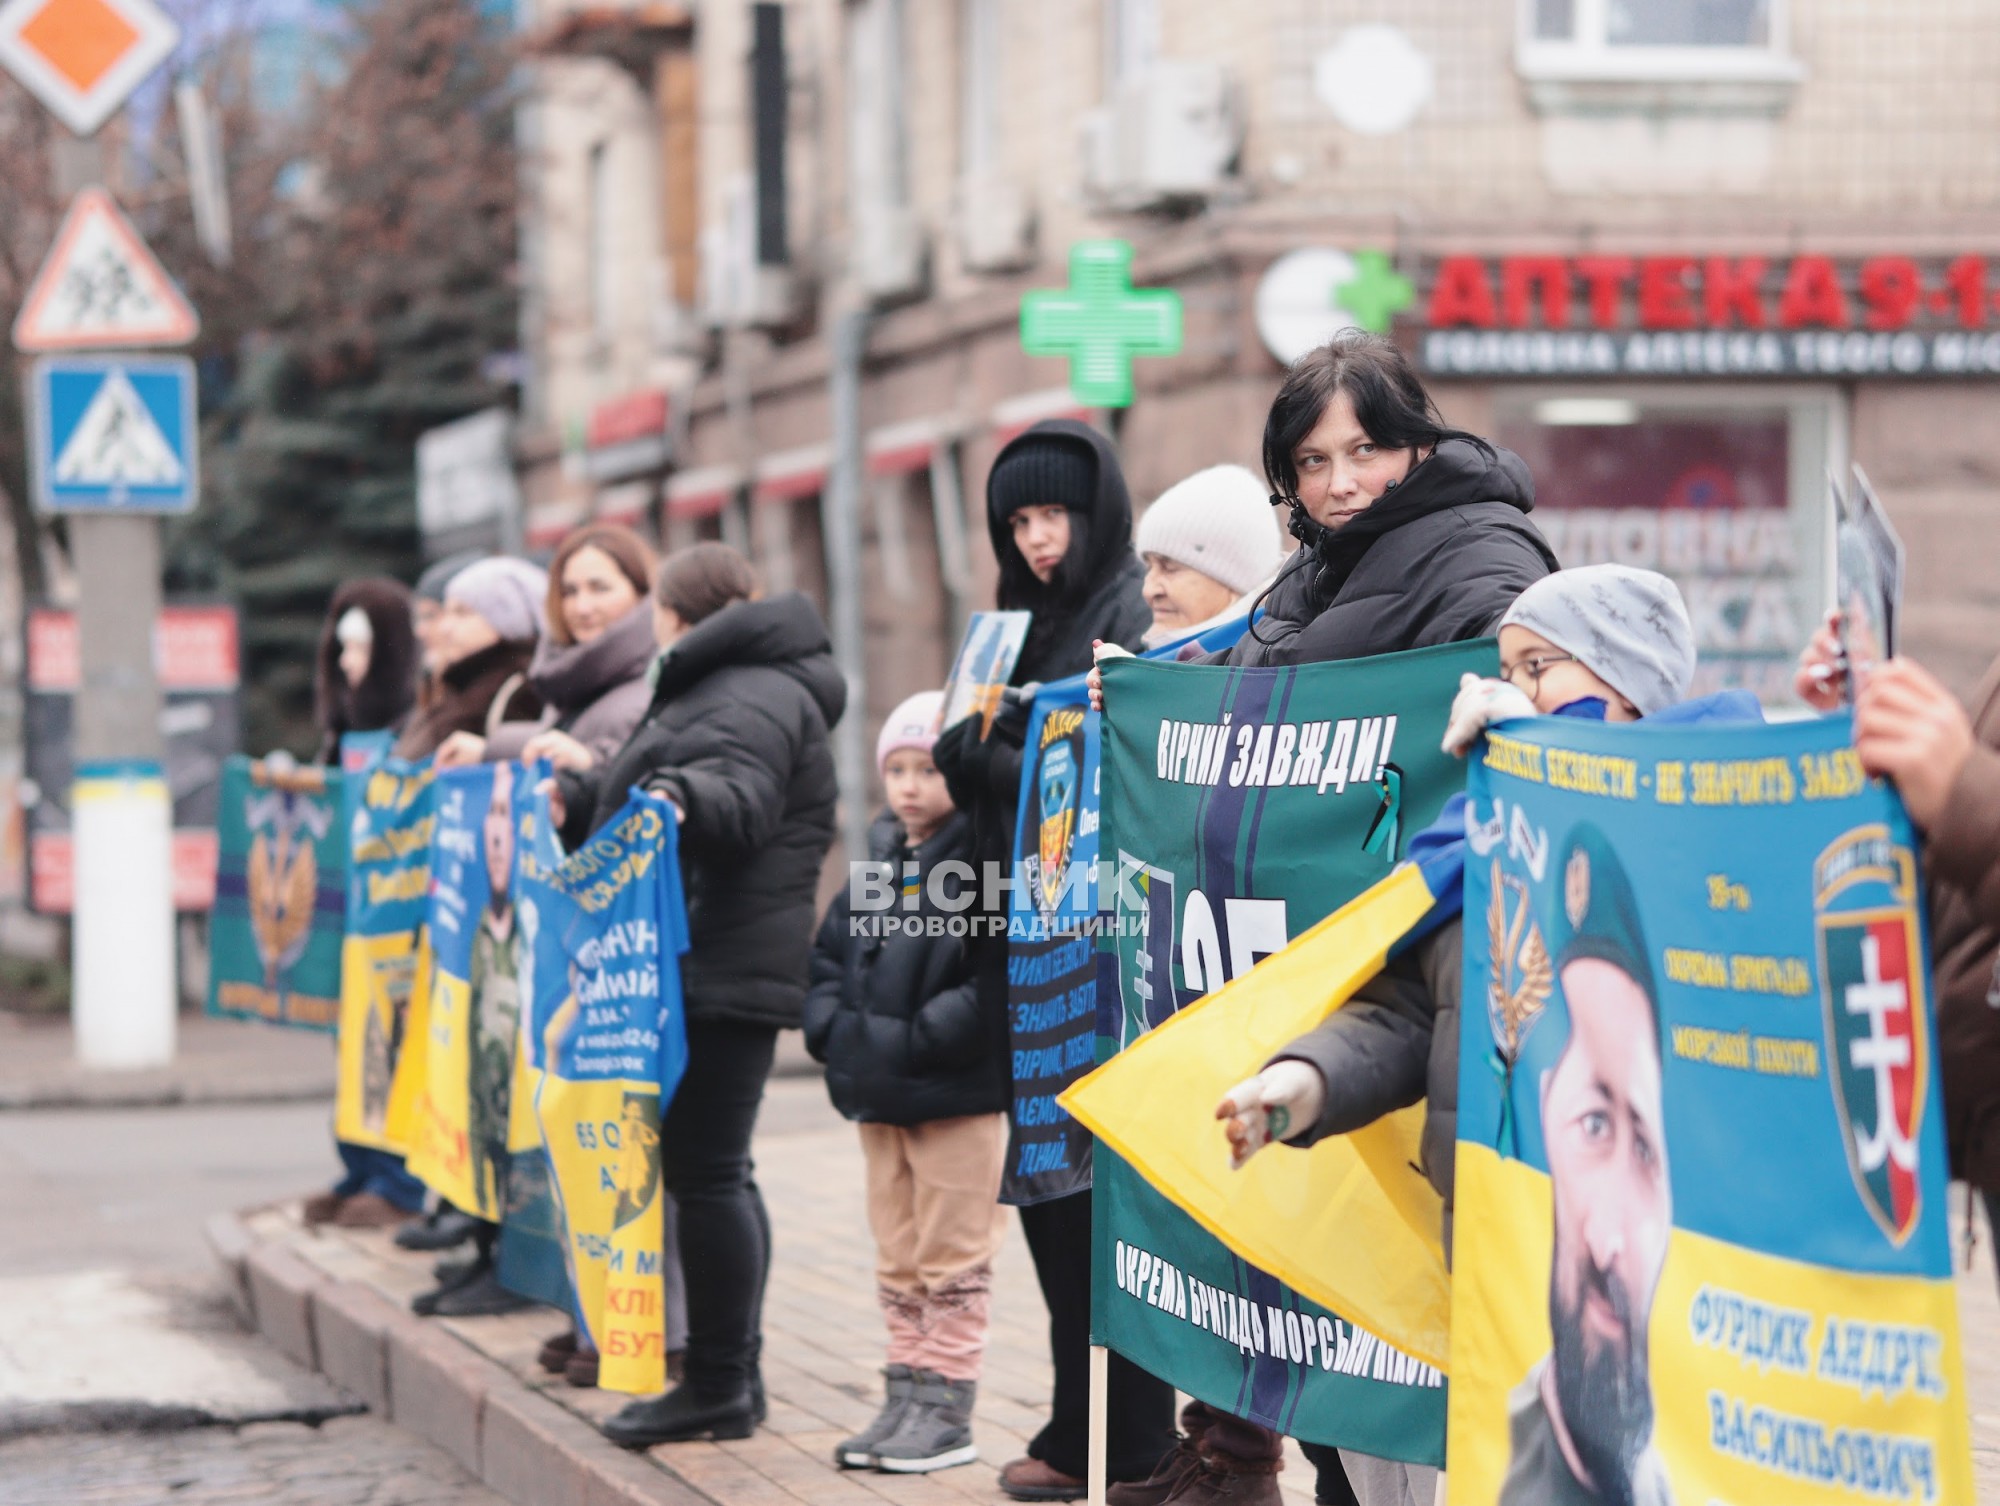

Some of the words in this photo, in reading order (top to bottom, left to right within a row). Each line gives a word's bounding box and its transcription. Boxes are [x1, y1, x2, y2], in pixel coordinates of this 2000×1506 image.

[1427, 254, 1848, 329] АПТЕКА
[1157, 713, 1232, 786] ВІРНИЙ
[1228, 714, 1398, 795] ЗАВЖДИ!
[1115, 1239, 1186, 1320] ОКРЕМА
[1188, 1274, 1264, 1358] БРИГАДА
[1690, 1283, 1811, 1376] ФУРДИК
[1707, 1390, 1938, 1501] ВАСИЛЬОВИЧ
